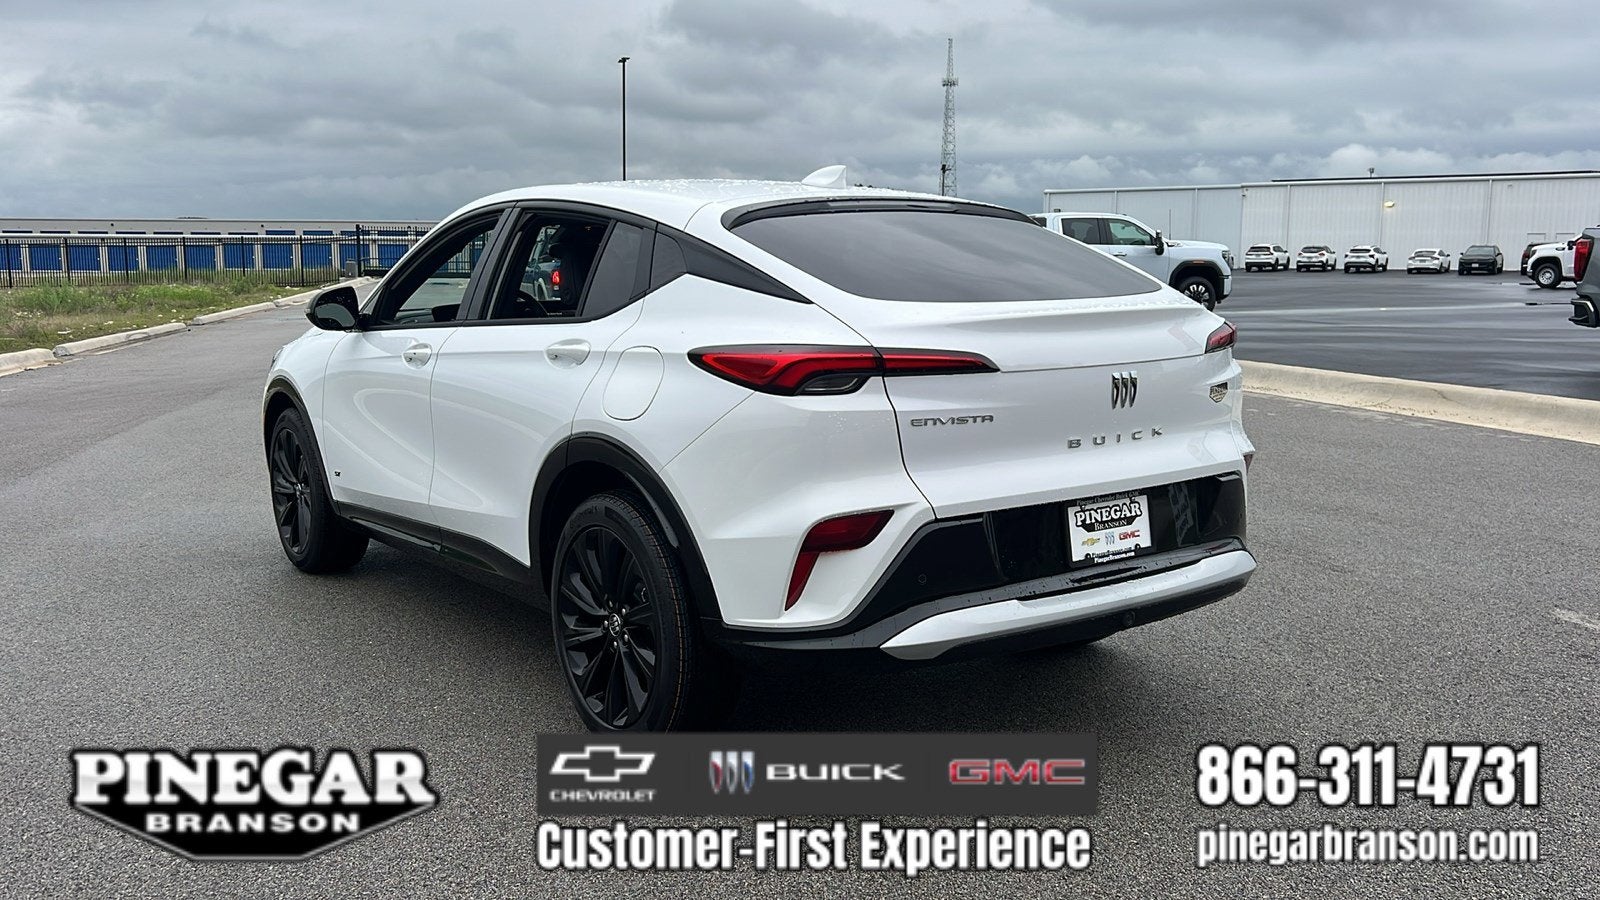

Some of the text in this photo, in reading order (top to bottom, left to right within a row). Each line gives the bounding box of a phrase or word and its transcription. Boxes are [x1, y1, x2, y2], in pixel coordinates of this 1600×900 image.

[910, 415, 994, 427] ENVISTA
[1067, 427, 1163, 449] BUICK
[1075, 502, 1142, 526] PINEGAR
[1119, 530, 1140, 540] GMC
